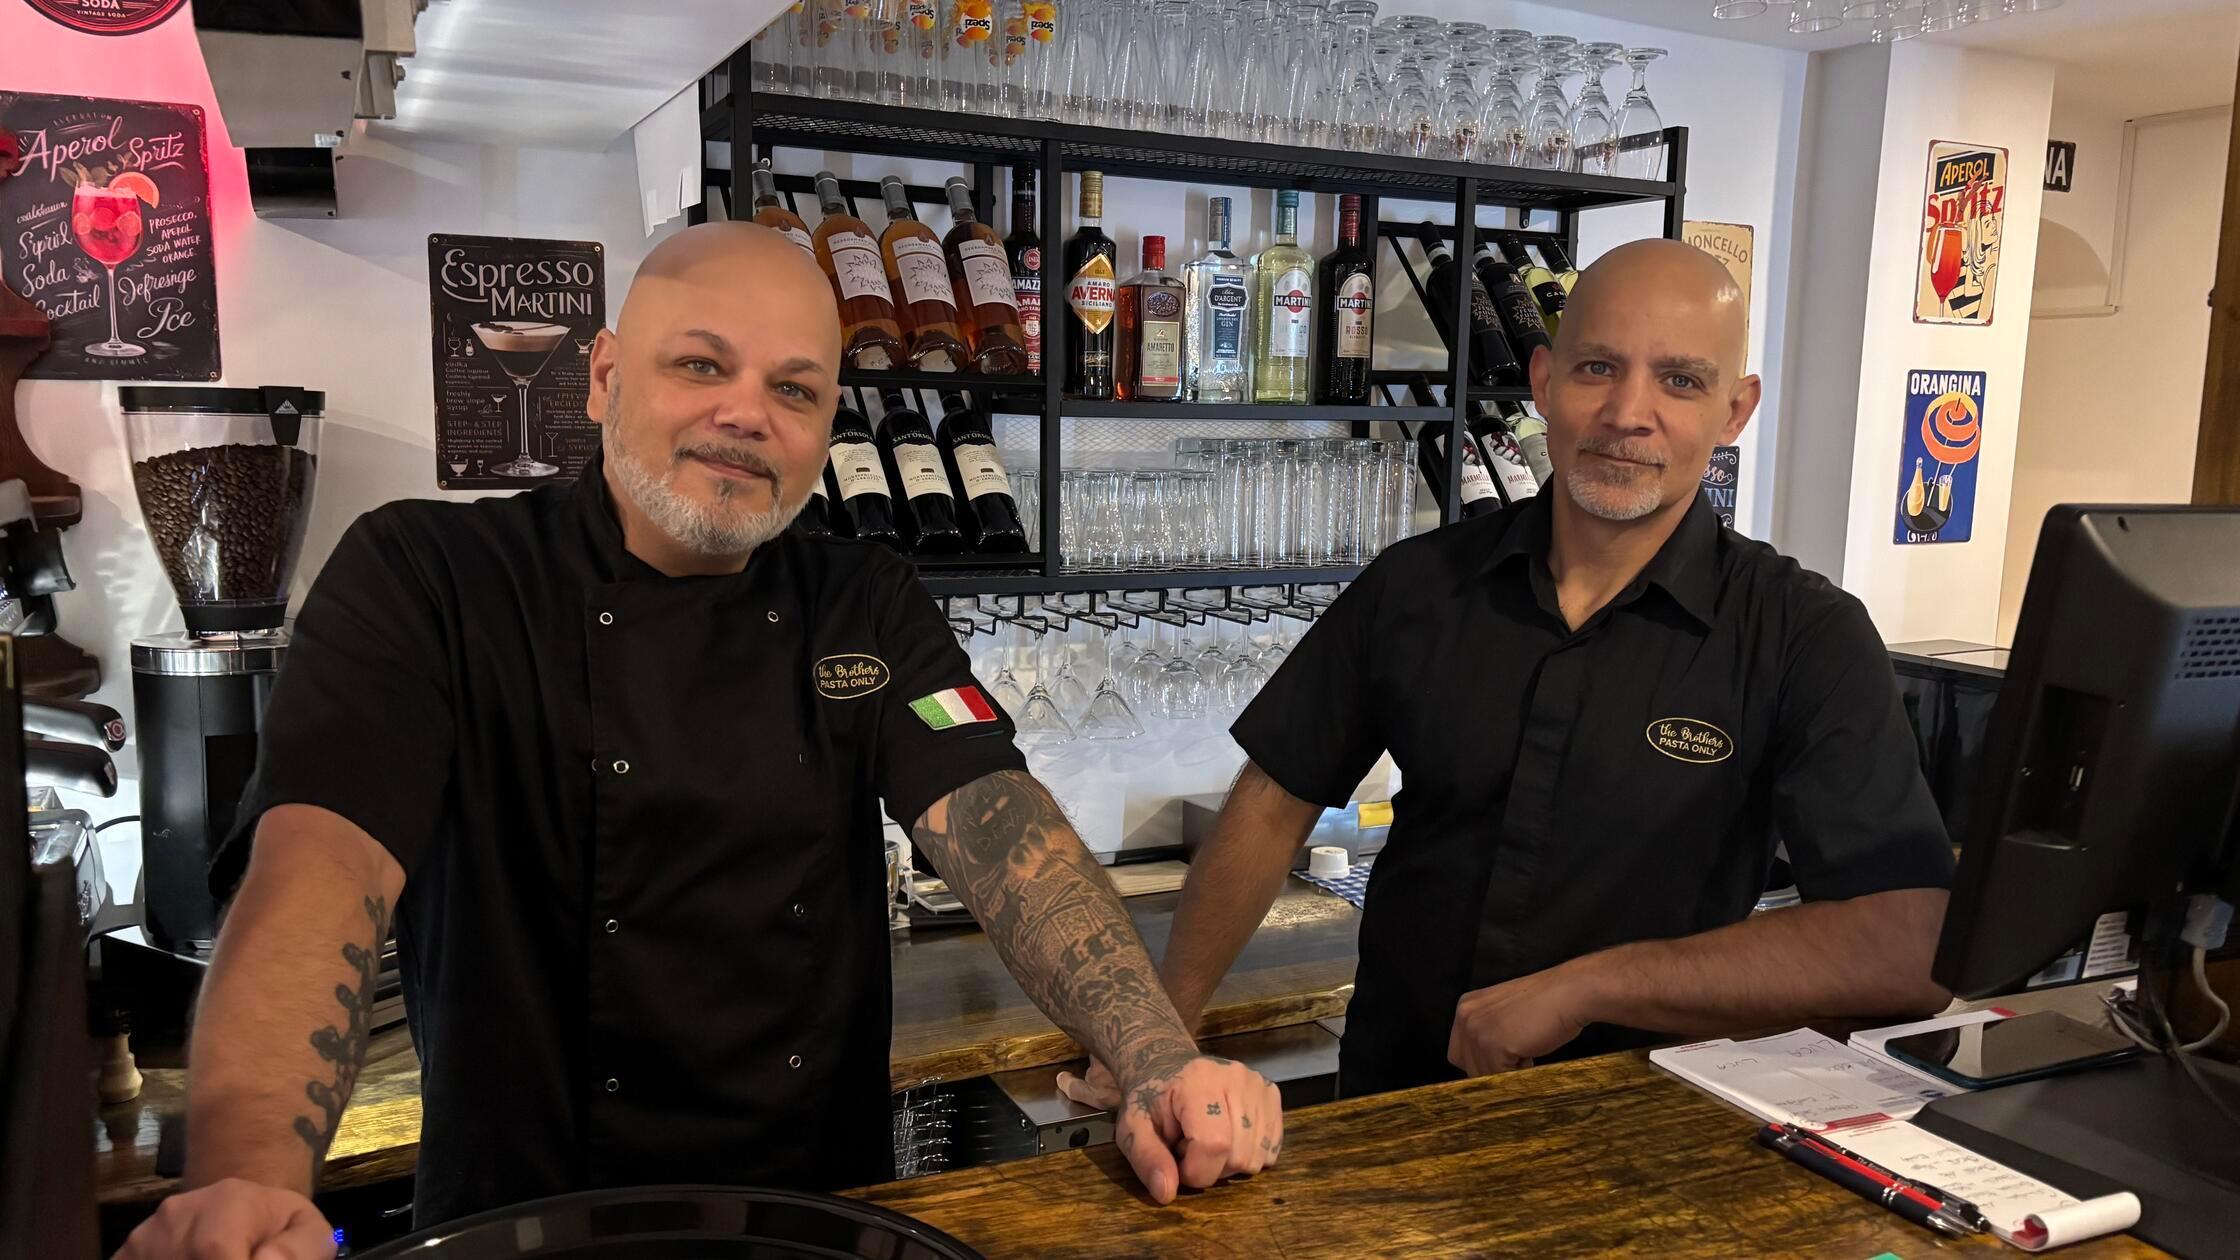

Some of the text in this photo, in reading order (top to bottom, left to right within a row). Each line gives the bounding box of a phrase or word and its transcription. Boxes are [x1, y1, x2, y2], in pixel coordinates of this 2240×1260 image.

[82, 0, 120, 9] SODA
[965, 18, 991, 30] Spezi
[1031, 20, 1054, 32] Spezi
[12, 116, 185, 183] Aperol Spritz
[1939, 156, 1990, 188] APEROL
[161, 224, 193, 241] APEROL
[146, 241, 171, 257] SODA
[22, 260, 70, 298] Soda
[441, 249, 594, 296] Espresso
[1081, 300, 1113, 308] SICILIANO
[1214, 295, 1243, 303] D'ARGENT
[1345, 326, 1368, 336] ROSSO
[1146, 341, 1175, 353] AMARETTO
[1910, 372, 1981, 396] ORANGINA
[818, 661, 880, 679] the Brothers
[820, 676, 877, 689] PASTA ONLY
[1659, 723, 1724, 749] the Brothers
[1659, 737, 1718, 757] PASTA ONLY
